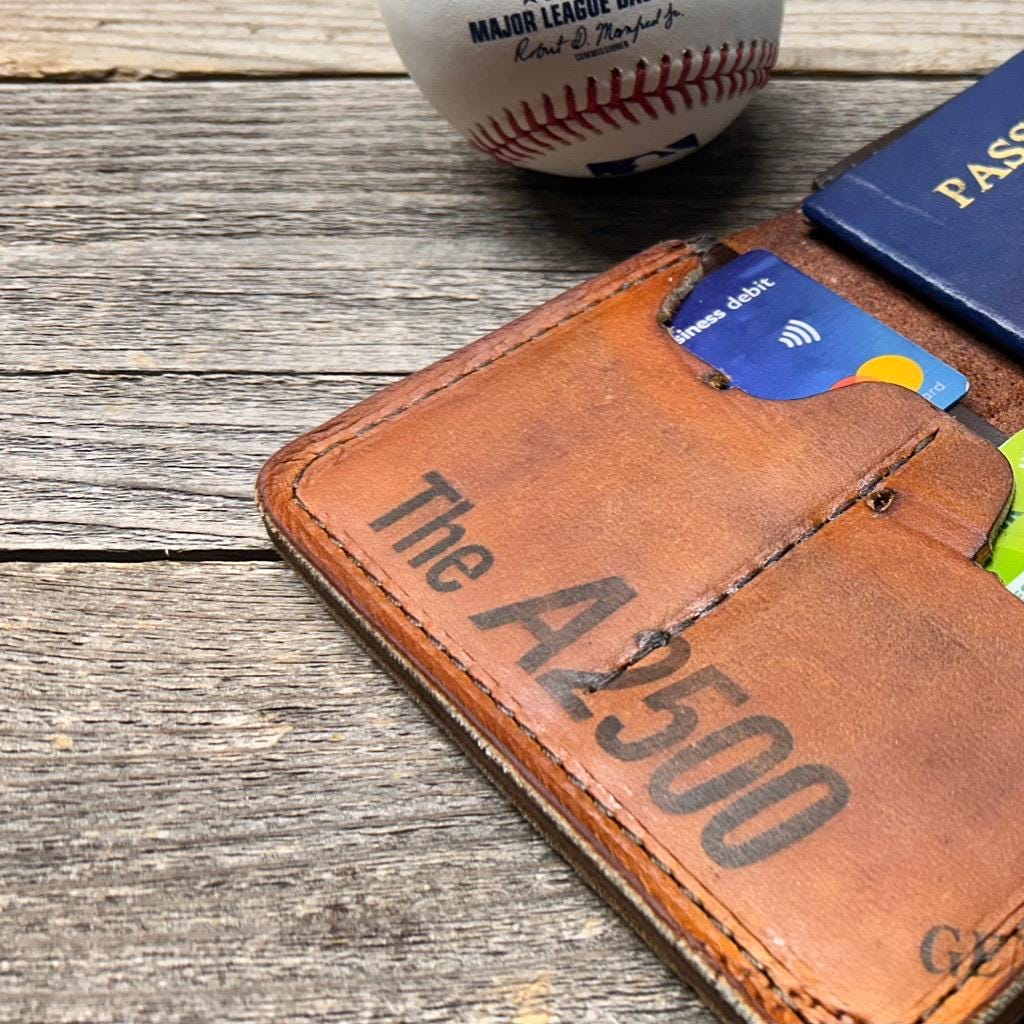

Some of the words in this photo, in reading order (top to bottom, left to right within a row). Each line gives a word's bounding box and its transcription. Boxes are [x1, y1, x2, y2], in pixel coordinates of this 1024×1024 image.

[468, 10, 538, 44] MAJOR
[541, 0, 611, 29] LEAGUE
[727, 278, 776, 310] debit
[368, 471, 494, 592] The
[468, 575, 851, 869] A2500
